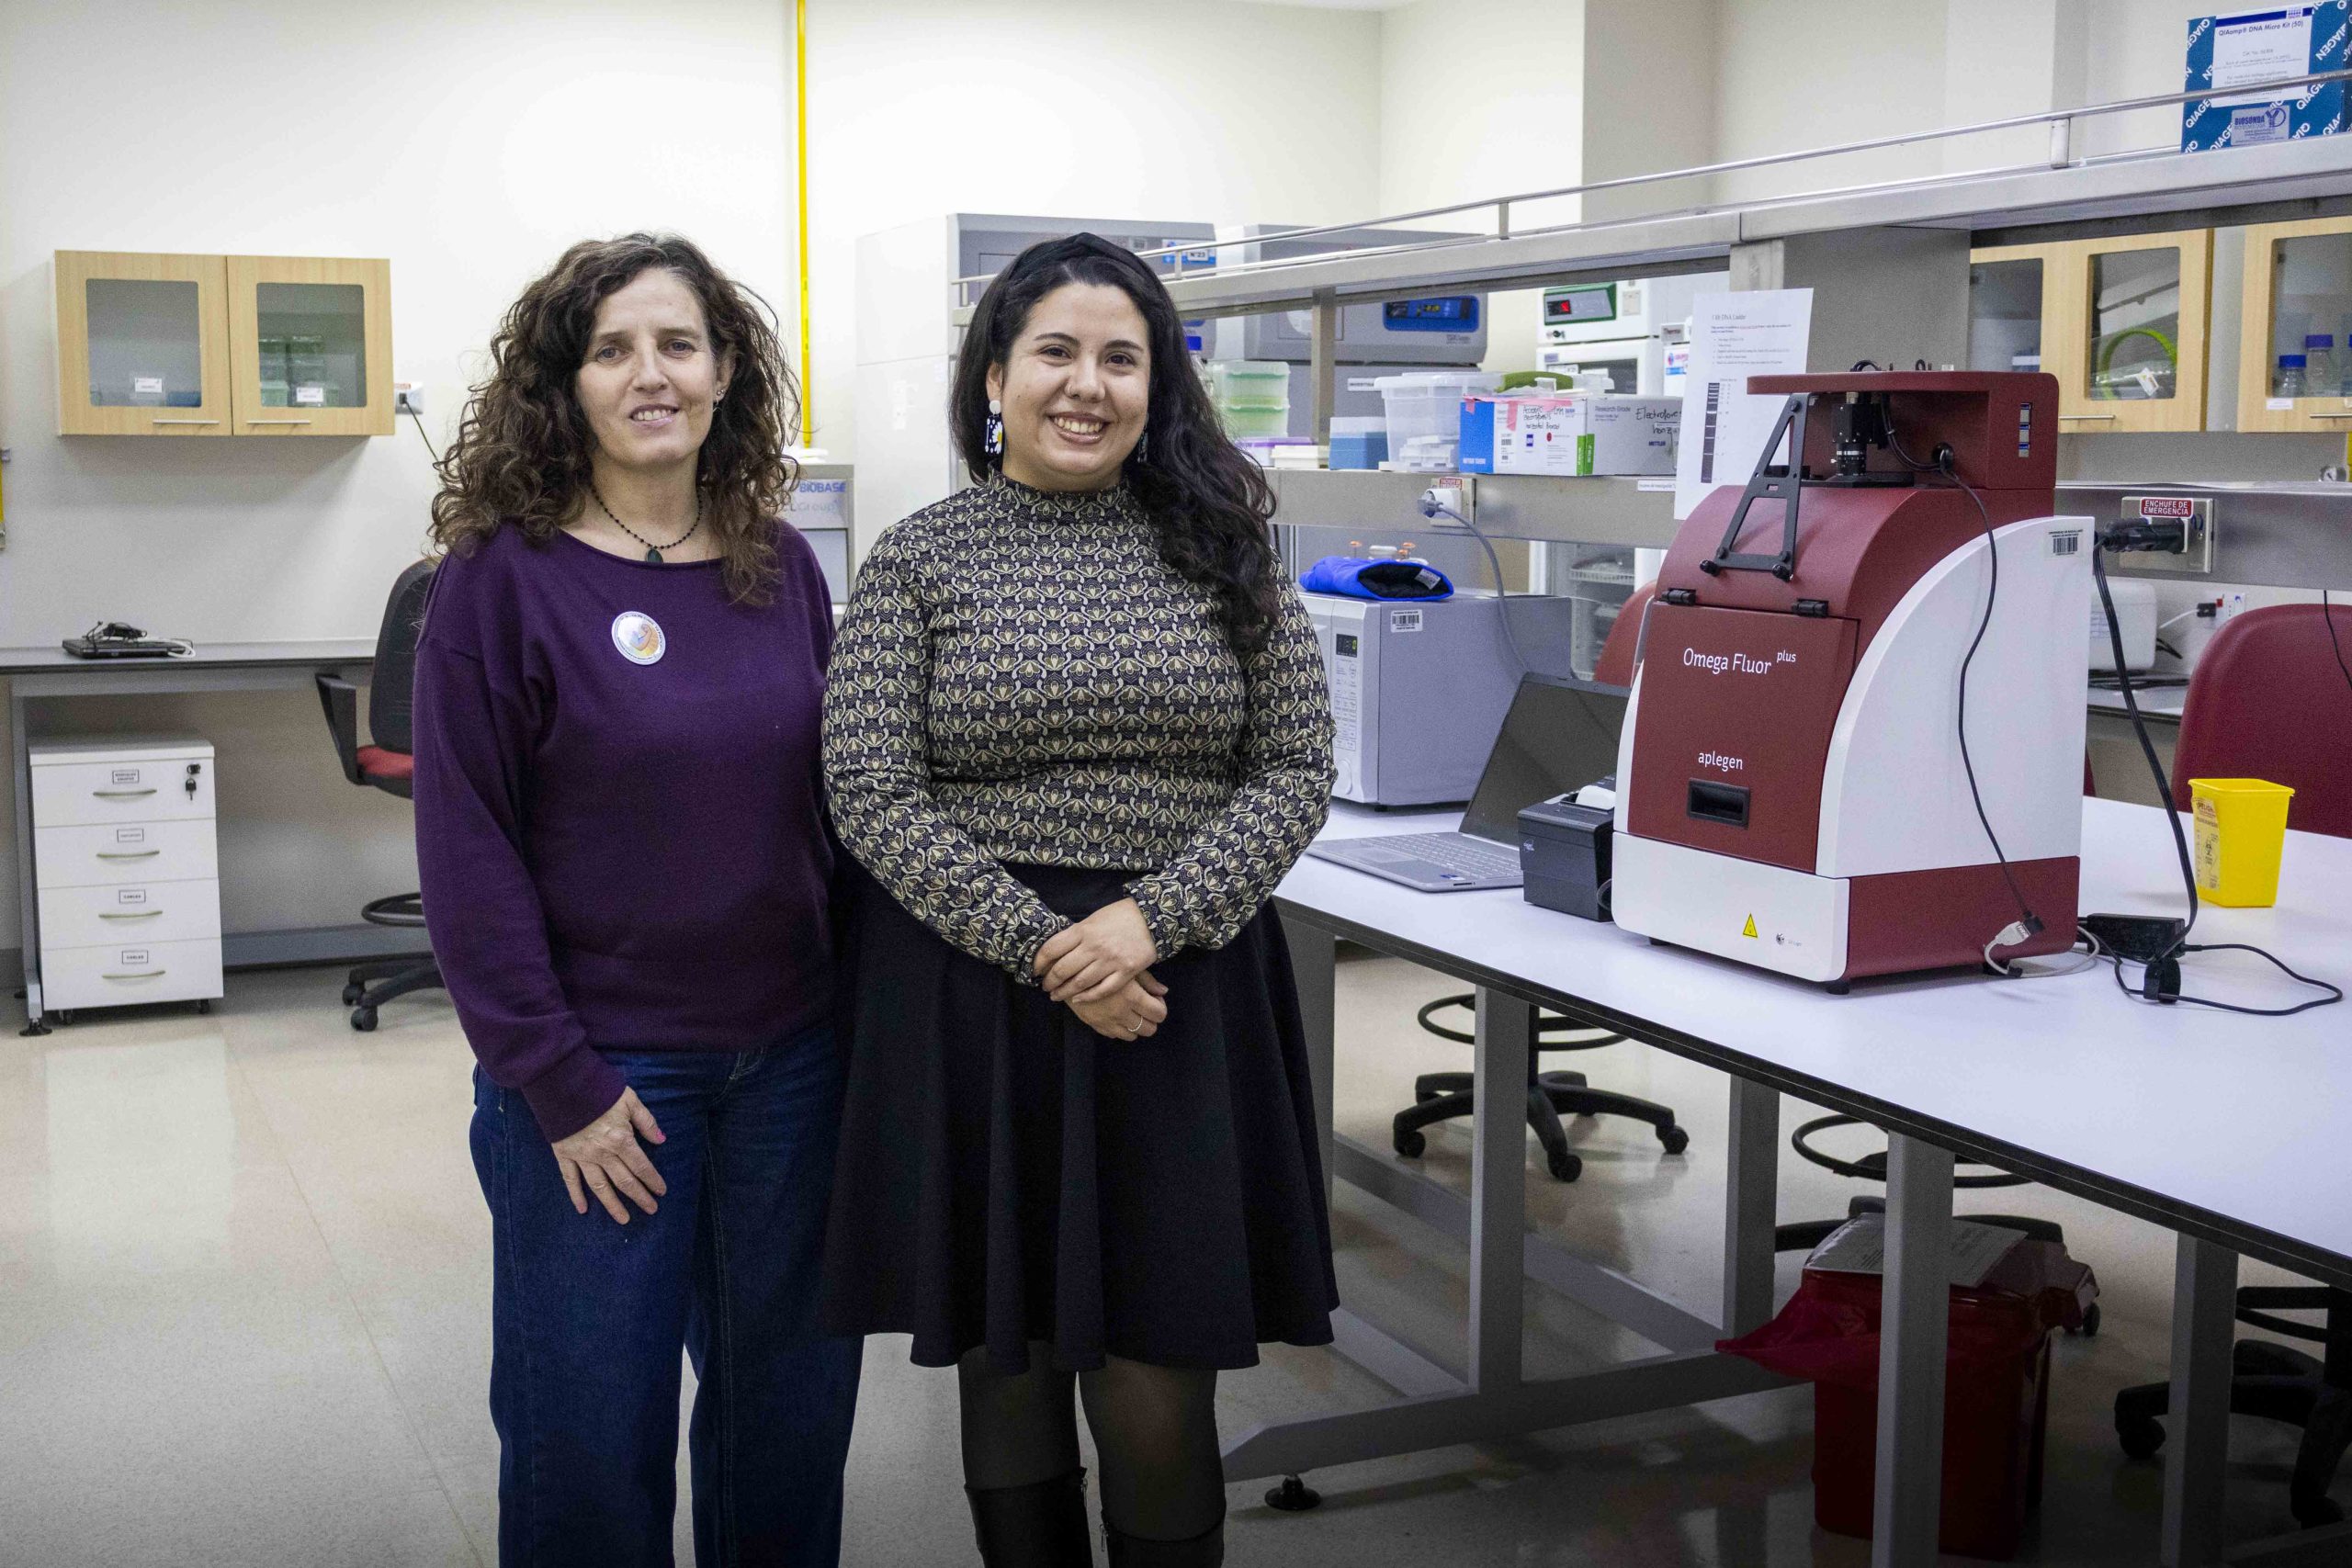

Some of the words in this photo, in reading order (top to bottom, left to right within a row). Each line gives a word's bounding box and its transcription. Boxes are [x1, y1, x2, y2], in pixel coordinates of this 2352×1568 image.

[2248, 25, 2263, 33] DNA
[2264, 23, 2281, 31] Micro
[2186, 98, 2212, 129] QIAGE
[2234, 115, 2265, 126] BIOSONDA
[799, 482, 846, 493] BIOBASE
[2145, 500, 2177, 509] ENCHUFE
[2178, 501, 2188, 509] DE
[2143, 507, 2188, 515] EMERGENCIA
[1683, 648, 1728, 675] Omega
[1733, 653, 1772, 675] Fluor
[1776, 649, 1796, 663] plus
[1698, 750, 1743, 772] aplegen
